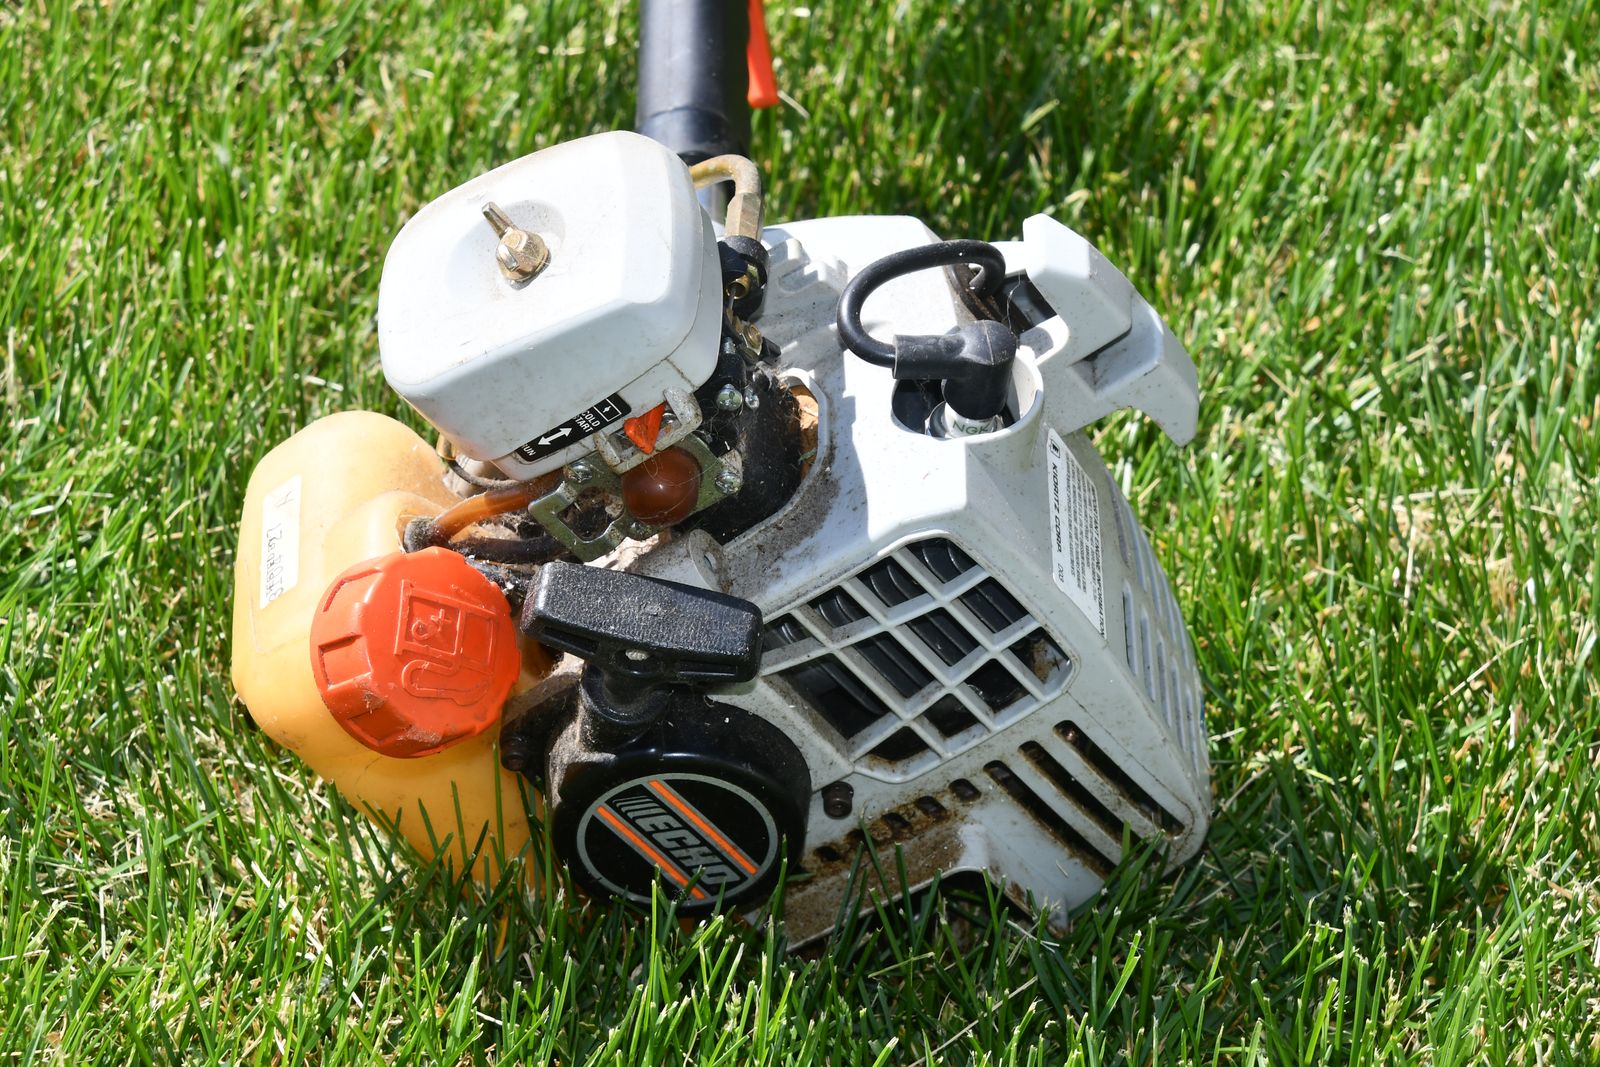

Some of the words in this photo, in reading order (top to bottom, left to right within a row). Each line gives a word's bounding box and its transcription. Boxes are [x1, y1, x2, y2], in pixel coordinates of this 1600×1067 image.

[573, 415, 594, 433] TART
[952, 419, 990, 436] NGK
[1052, 462, 1060, 513] KIORITZ
[632, 808, 742, 886] ECHO
